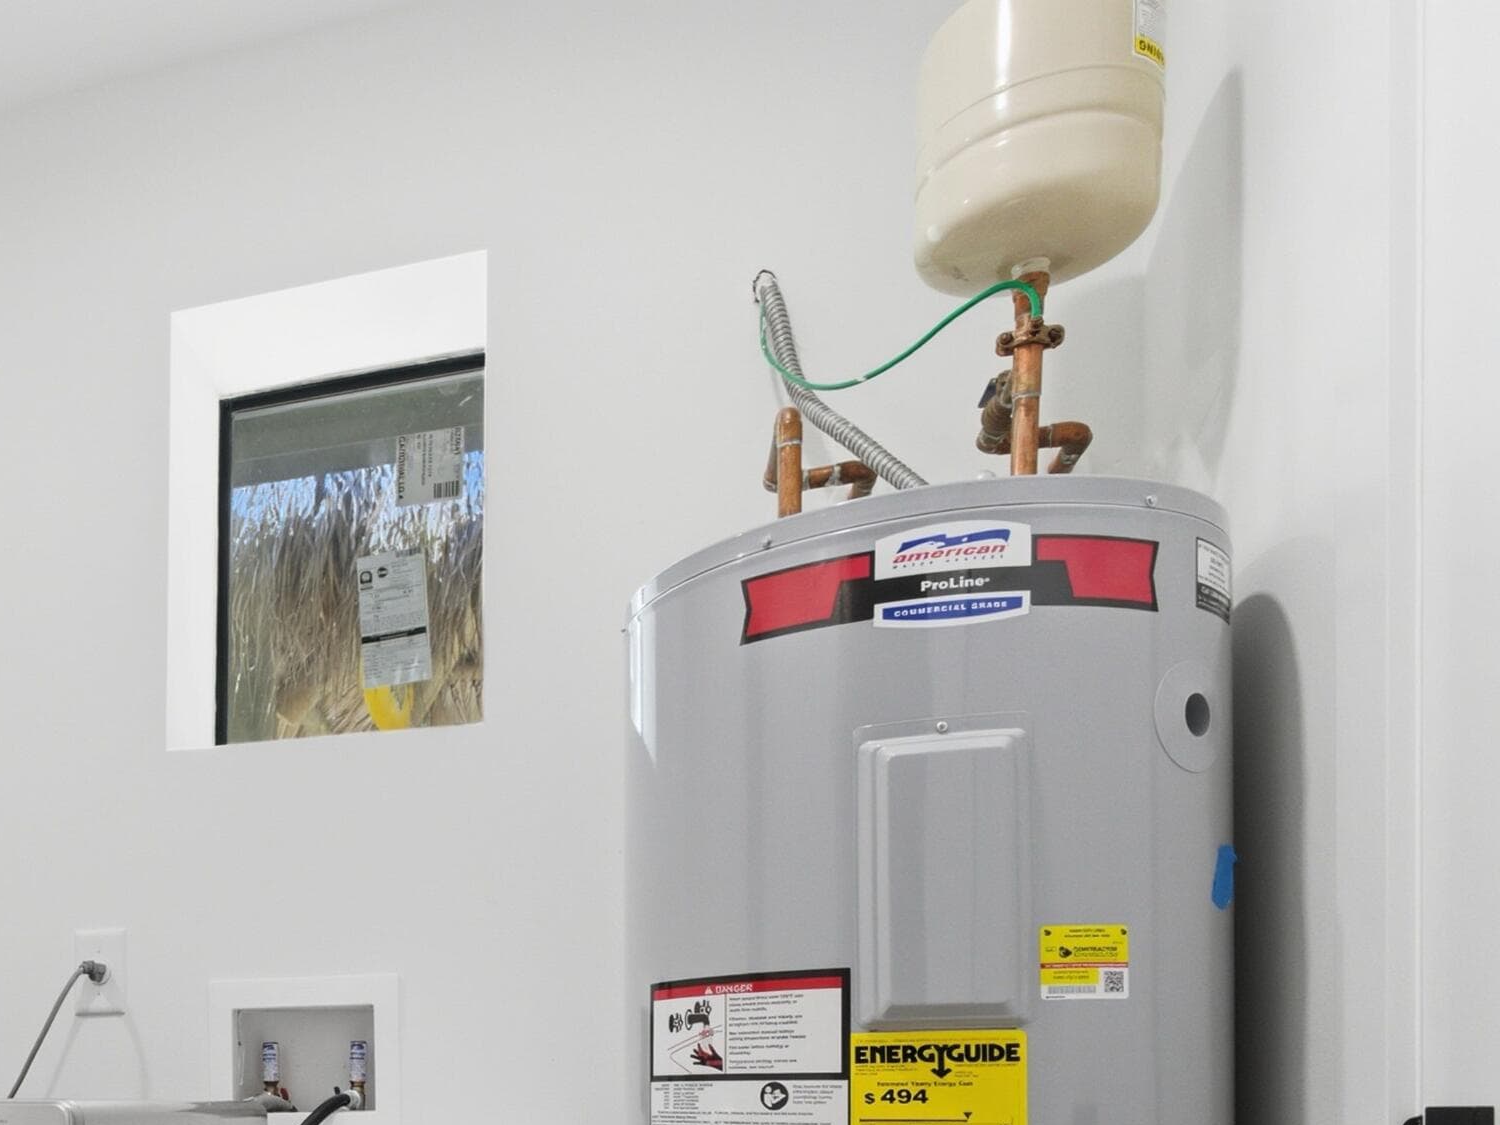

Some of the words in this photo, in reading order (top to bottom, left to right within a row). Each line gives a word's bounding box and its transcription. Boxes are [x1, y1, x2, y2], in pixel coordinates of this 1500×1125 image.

[893, 544, 1006, 564] american
[920, 575, 985, 592] ProLine
[894, 604, 967, 618] COMMERCIAL
[971, 600, 1008, 610] GRADE
[715, 983, 753, 994] DANGER
[880, 1089, 929, 1104] 494
